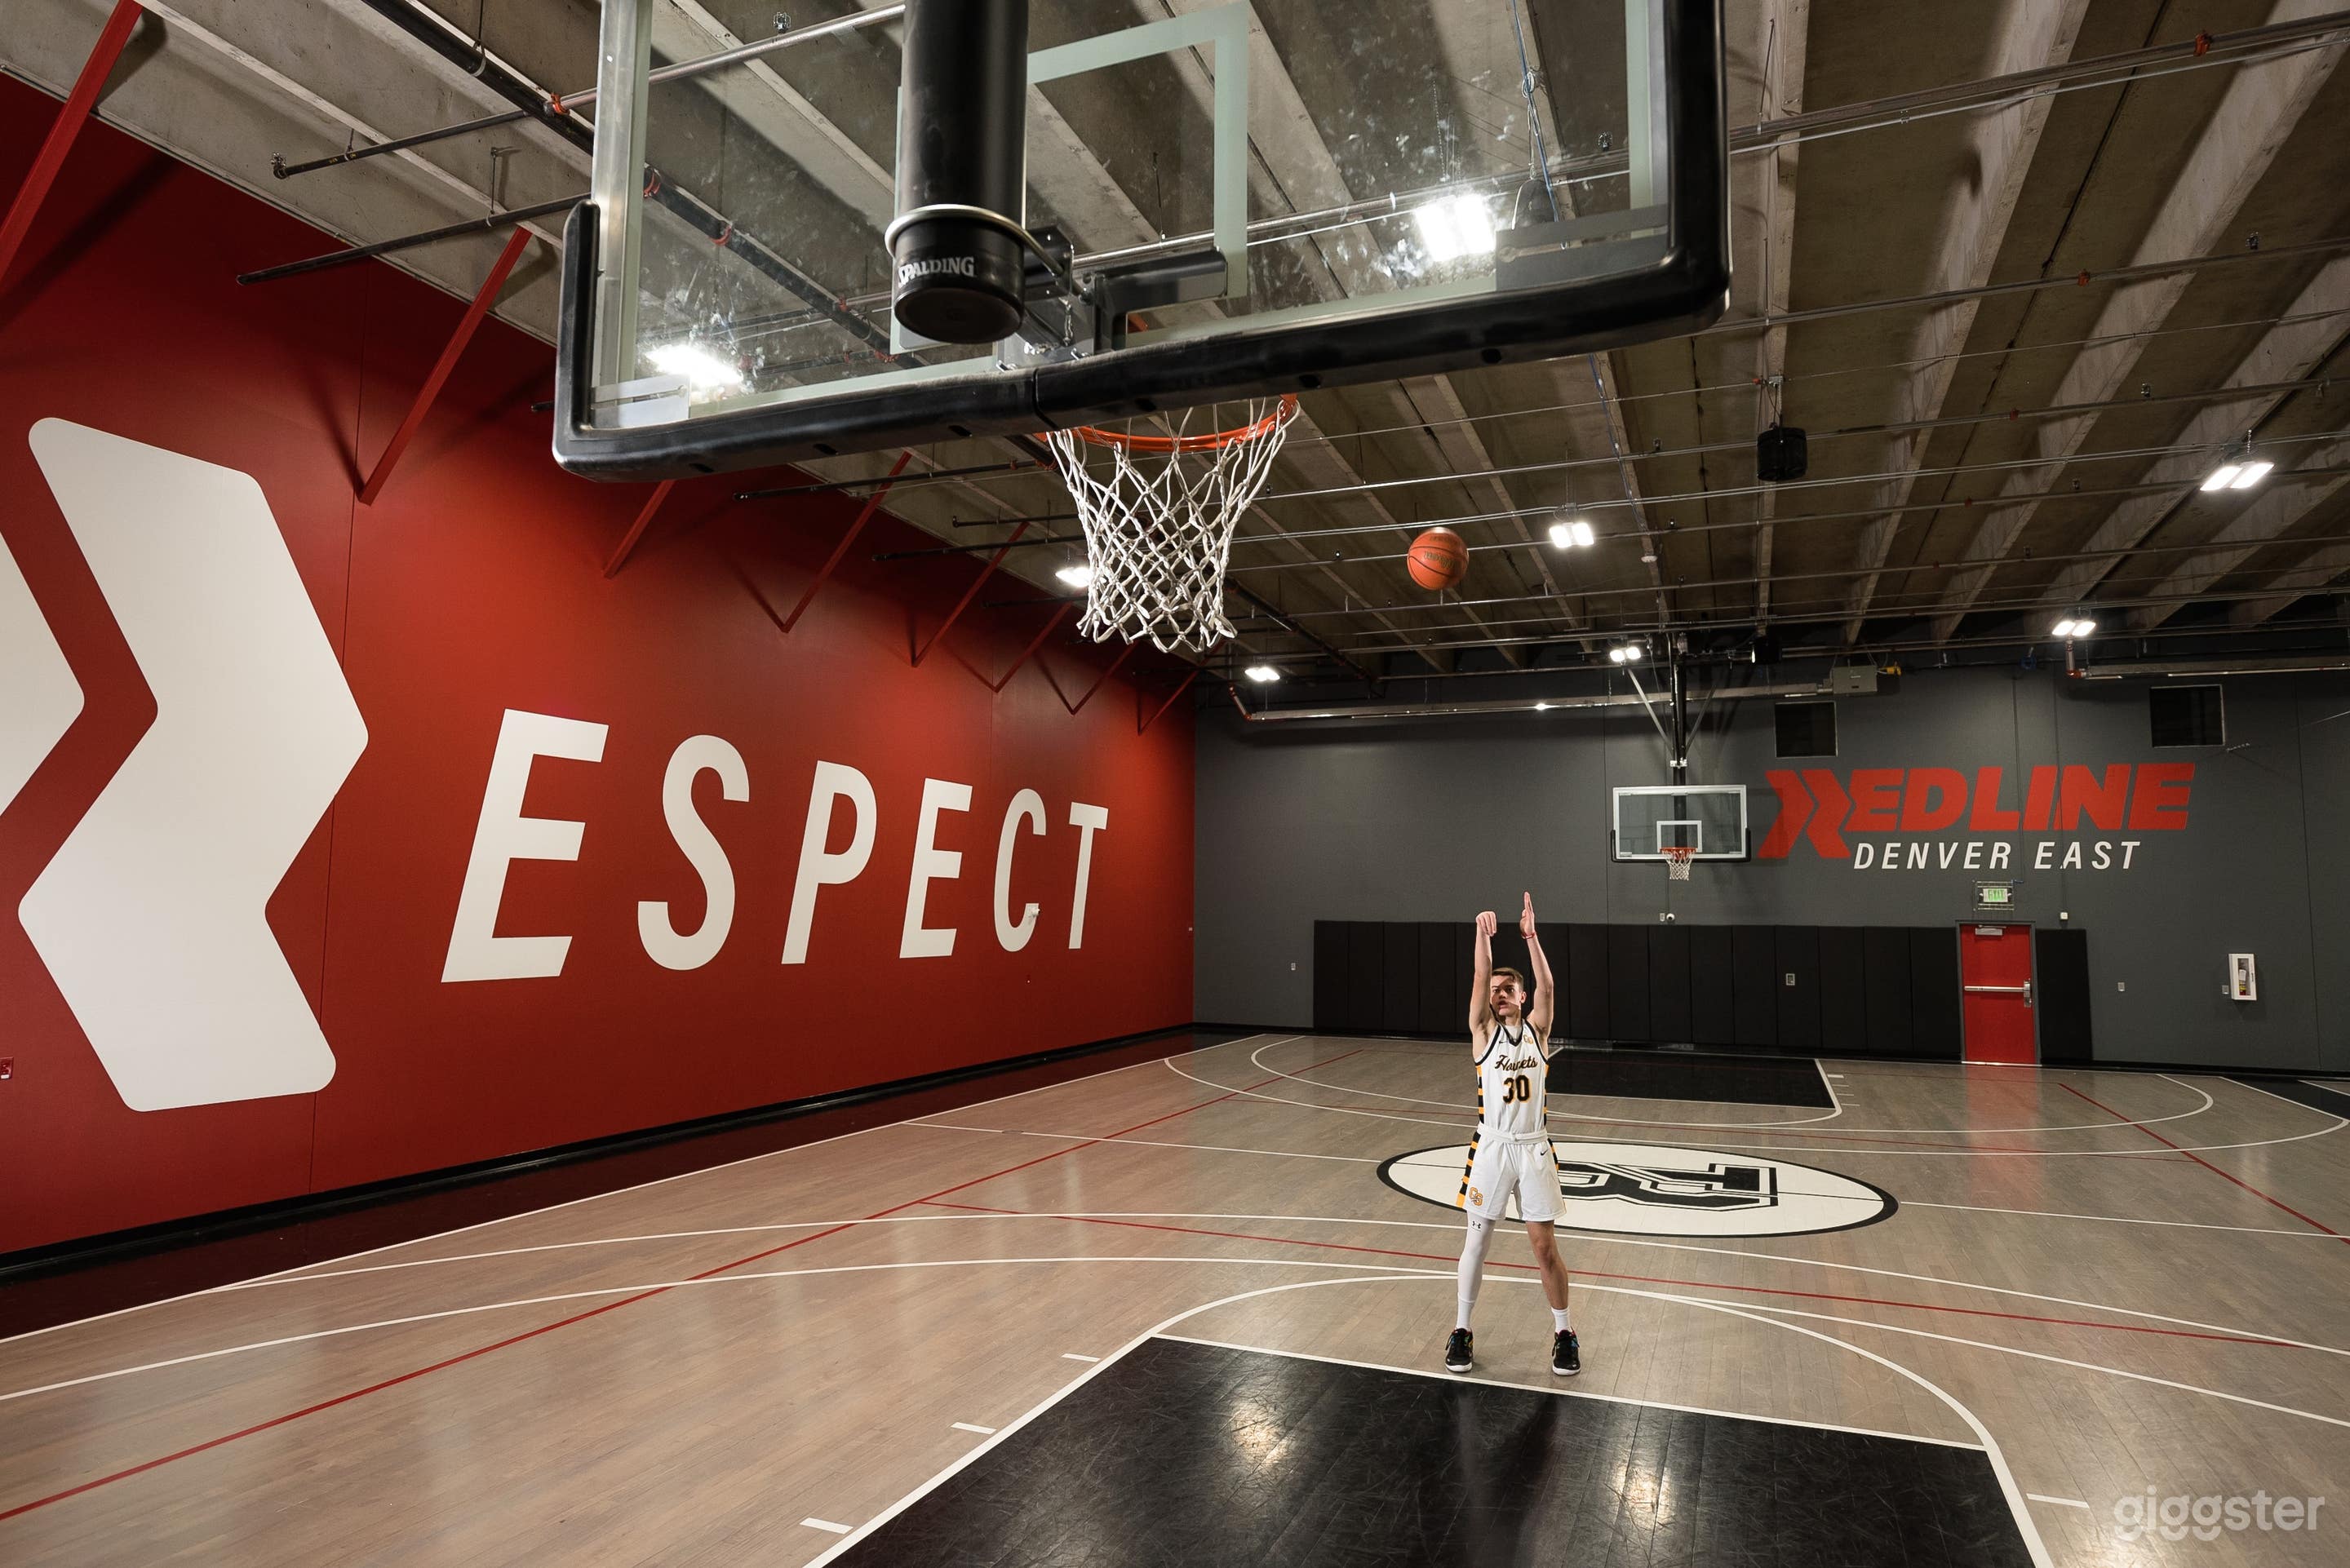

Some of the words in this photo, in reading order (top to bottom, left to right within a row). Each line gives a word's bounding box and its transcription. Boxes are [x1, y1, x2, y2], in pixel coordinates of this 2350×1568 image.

[898, 257, 974, 289] SPALDING
[1853, 842, 2011, 870] DENVER
[2034, 841, 2141, 870] EAST
[1988, 888, 2006, 901] EXIT
[1502, 1074, 1531, 1104] 30
